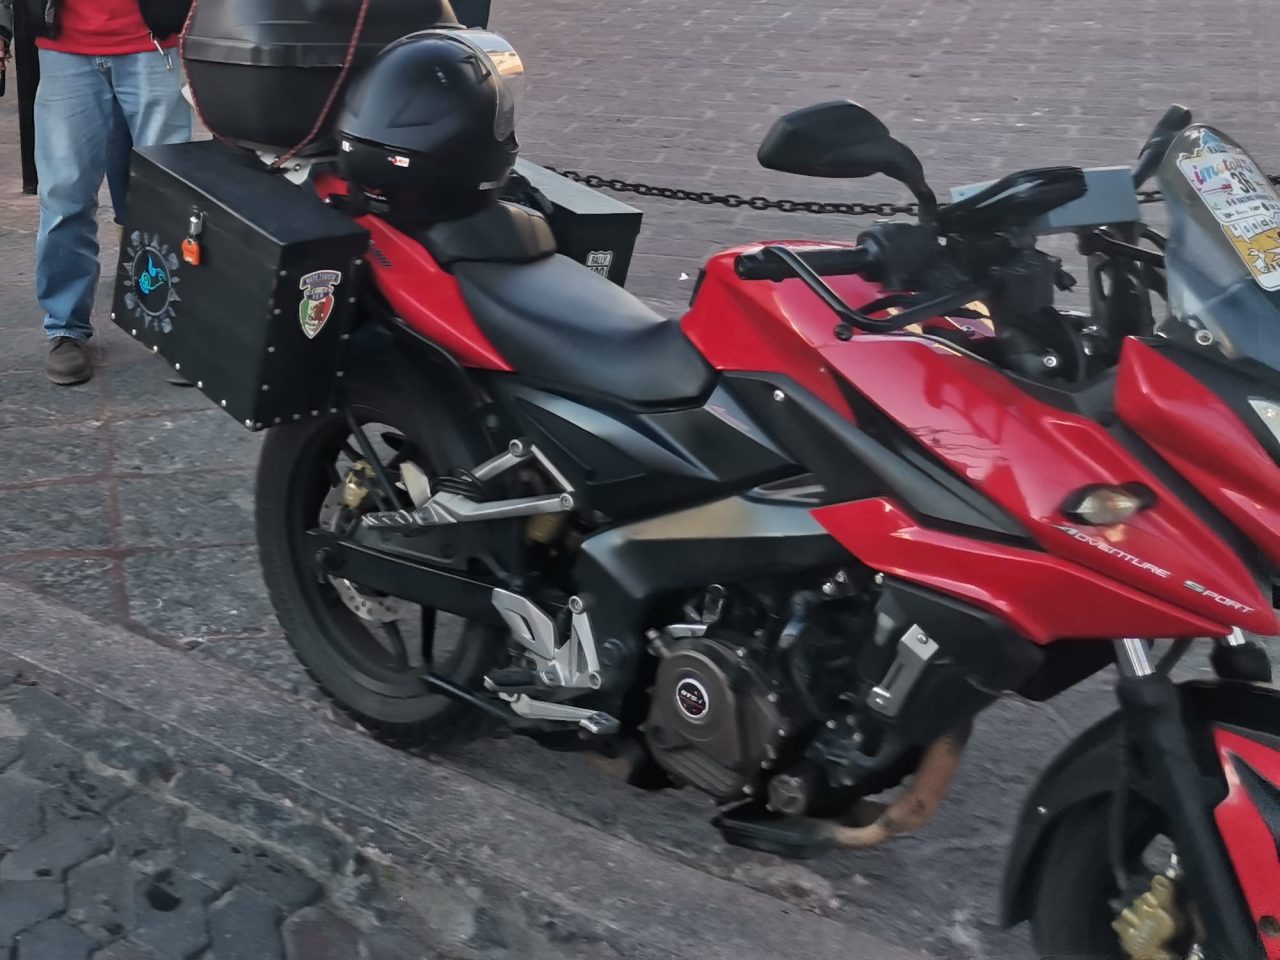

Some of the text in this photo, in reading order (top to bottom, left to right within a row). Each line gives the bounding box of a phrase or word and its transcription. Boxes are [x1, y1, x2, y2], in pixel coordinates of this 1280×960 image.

[1230, 171, 1257, 194] 36
[591, 255, 608, 265] RALLY
[1184, 580, 1255, 614] SPORT
